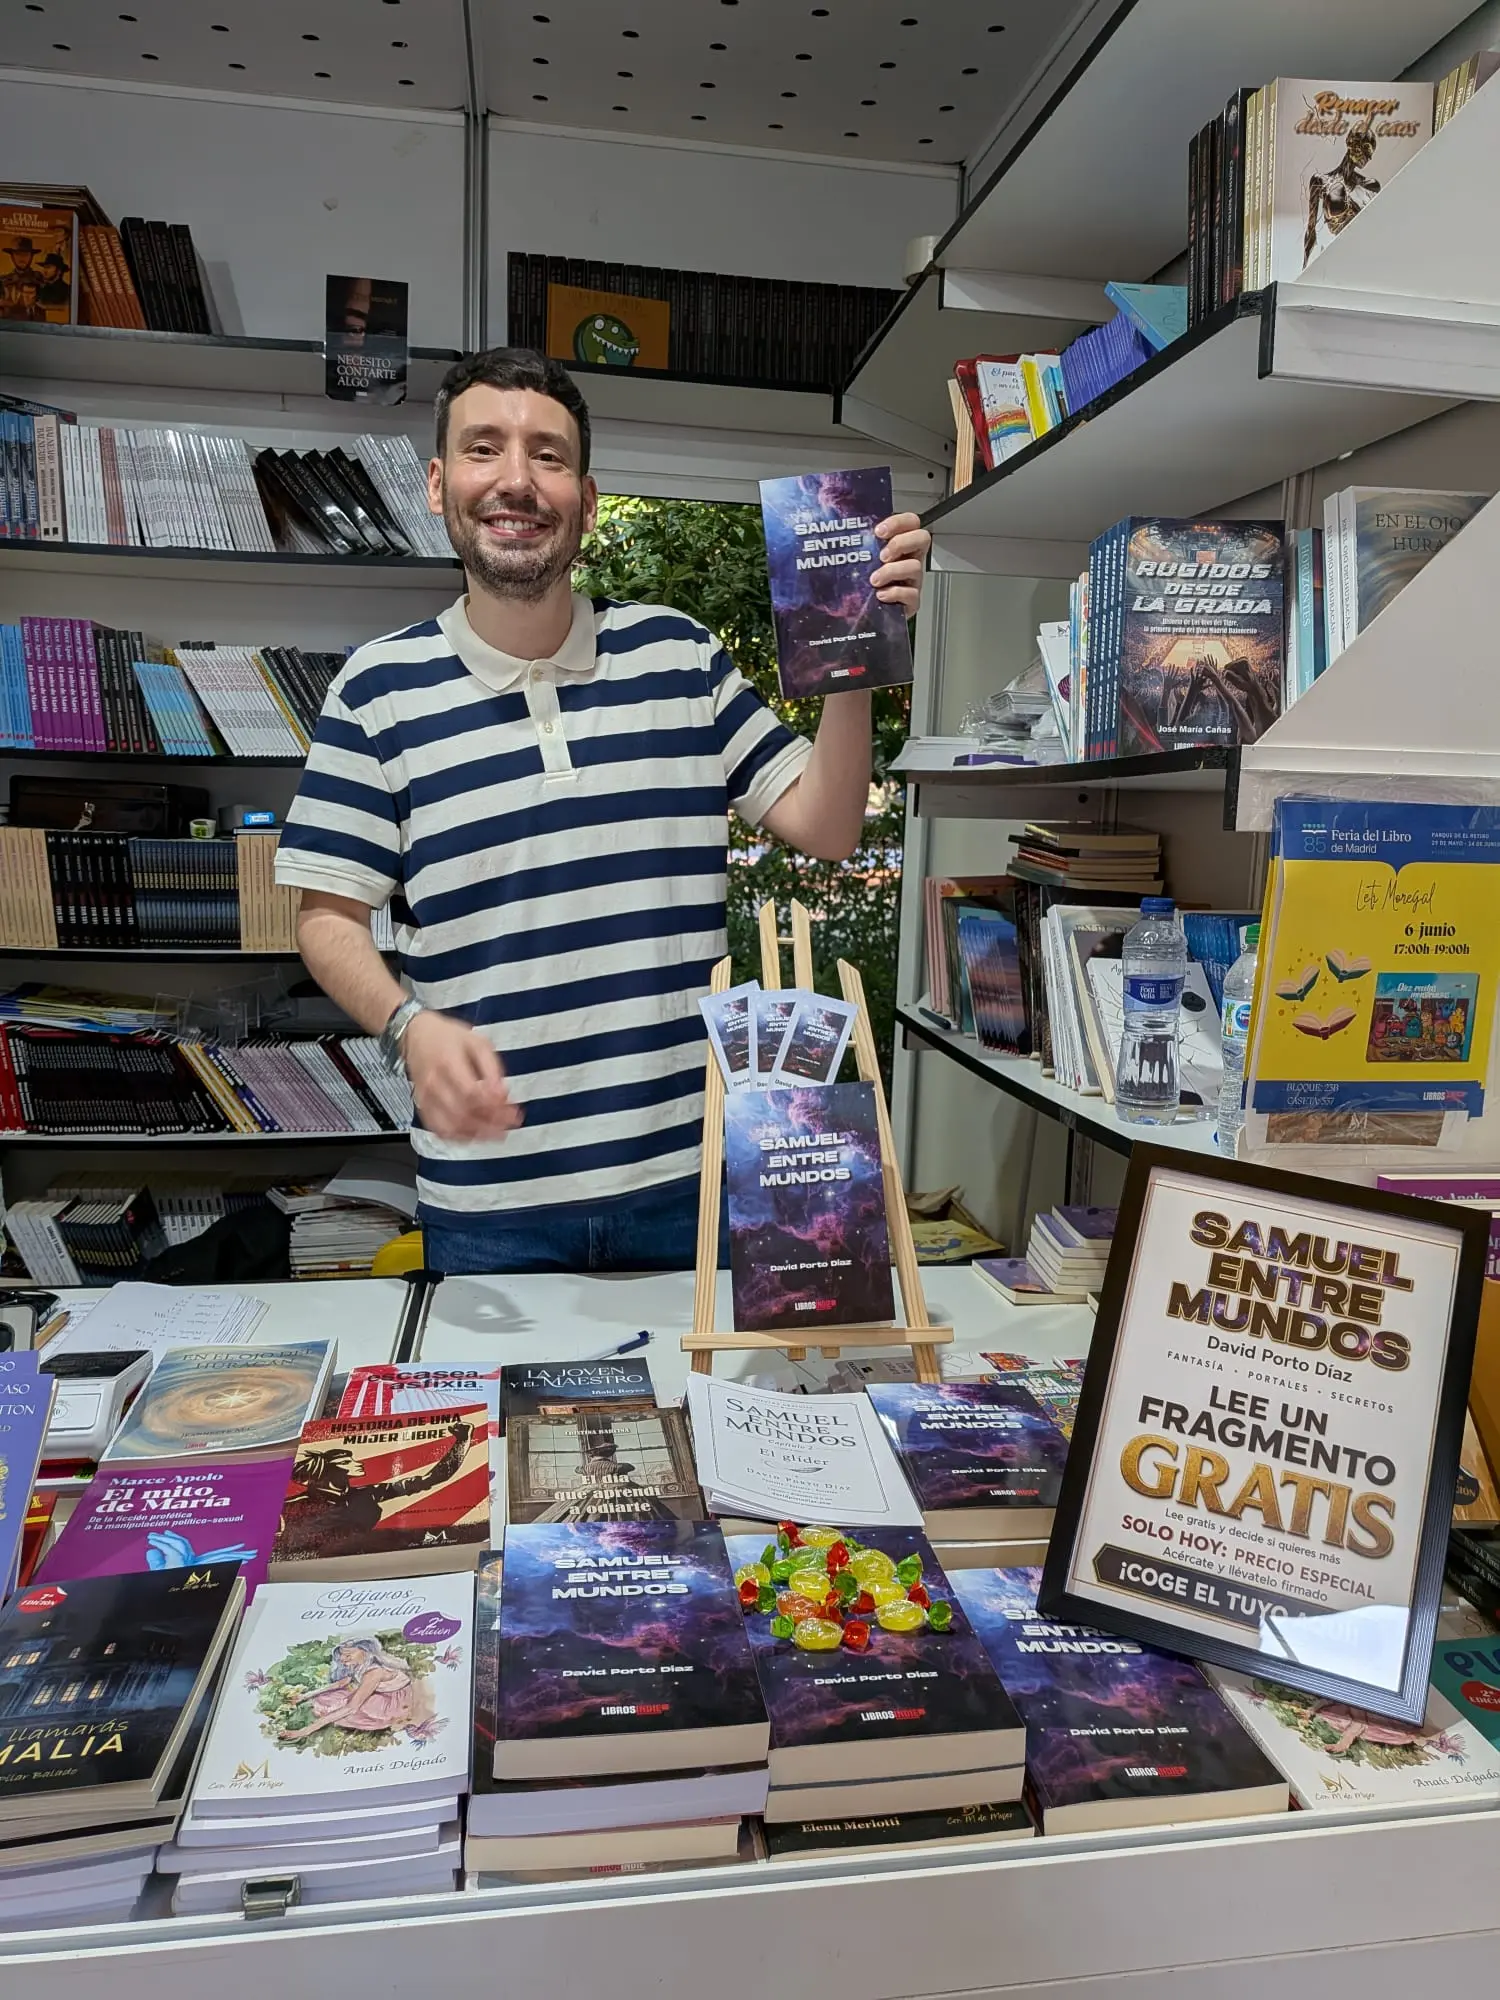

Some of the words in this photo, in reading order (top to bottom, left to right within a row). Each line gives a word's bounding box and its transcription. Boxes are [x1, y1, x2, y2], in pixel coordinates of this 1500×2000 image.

[1314, 91, 1400, 116] Renacer
[1294, 112, 1348, 136] desde
[1375, 119, 1421, 138] caos
[2, 217, 48, 228] EASTWOOD
[337, 354, 391, 369] NECESITO
[336, 366, 397, 380] CONTARTE
[337, 376, 369, 388] ALGO
[793, 517, 868, 536] SAMUEL
[1376, 514, 1400, 528] EN
[1404, 515, 1426, 529] EL
[1429, 516, 1464, 532] OJO
[802, 534, 862, 552] ENTRE
[796, 550, 872, 570] MUNDOS
[1136, 561, 1273, 579] RUGIDOS
[1164, 583, 1243, 596] DESDE
[1300, 543, 1311, 627] HORIZONTES
[1132, 596, 1166, 613] LA
[1174, 599, 1273, 615] GRADA
[809, 638, 832, 647] David
[833, 635, 857, 644] Porto
[1158, 724, 1177, 733] José
[1179, 725, 1203, 733] María
[1205, 725, 1232, 733] Cañas
[1331, 829, 1360, 841] Feria
[1362, 831, 1380, 842] del
[1382, 830, 1412, 842] Libro
[1331, 843, 1343, 853] de
[1345, 844, 1377, 854] Madrid
[1404, 924, 1414, 937] 6
[1418, 922, 1456, 939] junio
[1140, 985, 1155, 994] Font
[759, 1131, 845, 1151] SAMUEL
[768, 1151, 838, 1169] ENTRE
[759, 1167, 850, 1188] MUNDOS
[1189, 1210, 1414, 1292] SAMUEL
[770, 1263, 797, 1272] David
[799, 1261, 829, 1270] Porto
[830, 1258, 852, 1267] Díaz
[1207, 1252, 1385, 1326] ENTRE
[1165, 1281, 1411, 1372] MUNDOS
[183, 1353, 210, 1361] EN
[213, 1352, 236, 1361] EL
[238, 1350, 274, 1361] OJO
[195, 1358, 294, 1370] HURACÁN
[1207, 1336, 1256, 1361] David
[1261, 1348, 1310, 1373] Porto
[1315, 1361, 1353, 1384] Díaz
[527, 1369, 551, 1379] LA
[557, 1366, 624, 1378] JOVEN
[543, 1374, 643, 1388] MAESTRO
[1167, 1350, 1224, 1372] FANTASÍA
[1248, 1371, 1309, 1393] PORTALES
[1330, 1391, 1394, 1414] SECRETOS
[726, 1398, 849, 1426] SAMUEL
[912, 1404, 1008, 1412] SAMUEL
[926, 1412, 1002, 1420] ENTRE
[1209, 1385, 1269, 1421] LEE
[1280, 1402, 1328, 1436] UN
[331, 1417, 401, 1433] HISTORIA
[407, 1416, 426, 1427] DE
[430, 1412, 461, 1424] UNA
[748, 1414, 830, 1435] ENTRE
[920, 1421, 1023, 1430] MUNDOS
[343, 1432, 398, 1445] MUJER
[401, 1429, 447, 1441] LIBRE
[724, 1416, 856, 1447] MUNDOS
[1138, 1395, 1397, 1486] FRAGMENTO
[760, 1448, 775, 1457] El
[782, 1454, 830, 1465] glider
[109, 1477, 167, 1486] Marce
[169, 1473, 224, 1484] Apolo
[582, 1475, 596, 1485] El
[602, 1473, 629, 1483] día
[101, 1488, 135, 1501] El
[140, 1485, 214, 1499] mito
[554, 1490, 587, 1503] que
[592, 1486, 662, 1500] aprendí
[1120, 1433, 1397, 1559] GRATIS
[95, 1500, 134, 1513] de
[141, 1494, 231, 1511] María
[569, 1505, 581, 1515] a
[586, 1502, 651, 1514] odiarte
[93, 1522, 103, 1530] la
[104, 1521, 170, 1530] manipulación
[171, 1515, 244, 1527] político-sexual
[103, 1514, 114, 1523] la
[115, 1513, 148, 1522] ficción
[1165, 1507, 1183, 1520] Lee
[1186, 1512, 1216, 1532] gratis
[1218, 1524, 1227, 1534] y
[1228, 1525, 1264, 1543] decide
[1266, 1535, 1276, 1546] si
[1278, 1539, 1316, 1558] quieres
[1319, 1550, 1341, 1565] más
[554, 1555, 681, 1569] SAMUEL
[1121, 1514, 1174, 1542] SOLO
[1179, 1530, 1228, 1557] HOY:
[1234, 1548, 1294, 1576] PRECIO
[1299, 1567, 1375, 1599] ESPECIAL
[567, 1569, 670, 1583] ENTRE
[1162, 1546, 1214, 1570] Acércate
[1217, 1562, 1226, 1574] y
[1228, 1564, 1278, 1588] llévatelo
[1281, 1580, 1328, 1602] firmado
[318, 1588, 413, 1609] Pájaros
[552, 1583, 688, 1600] MUNDOS
[1118, 1561, 1189, 1597] ¡COGE
[1193, 1582, 1220, 1606] EL
[1227, 1590, 1289, 1619] TUYO
[301, 1610, 325, 1621] en
[329, 1607, 356, 1620] mi
[340, 1600, 424, 1626] jardín
[409, 1625, 451, 1637] Edición
[1016, 1641, 1142, 1655] MUNDOS
[562, 1668, 606, 1677] David
[610, 1667, 655, 1676] Porto
[660, 1664, 694, 1673] Díaz
[814, 1676, 857, 1685] David
[859, 1673, 903, 1683] Porto
[906, 1670, 938, 1679] Díaz
[1069, 1728, 1110, 1736] David
[1113, 1727, 1155, 1735] Porto
[1157, 1725, 1190, 1734] Díaz
[343, 1763, 385, 1775] Anaís
[389, 1754, 447, 1771] Delgado
[1413, 1776, 1450, 1787] Anaís
[1451, 1770, 1500, 1787] Delgado
[801, 1822, 841, 1833] Elena
[844, 1816, 901, 1831] Merlotti
